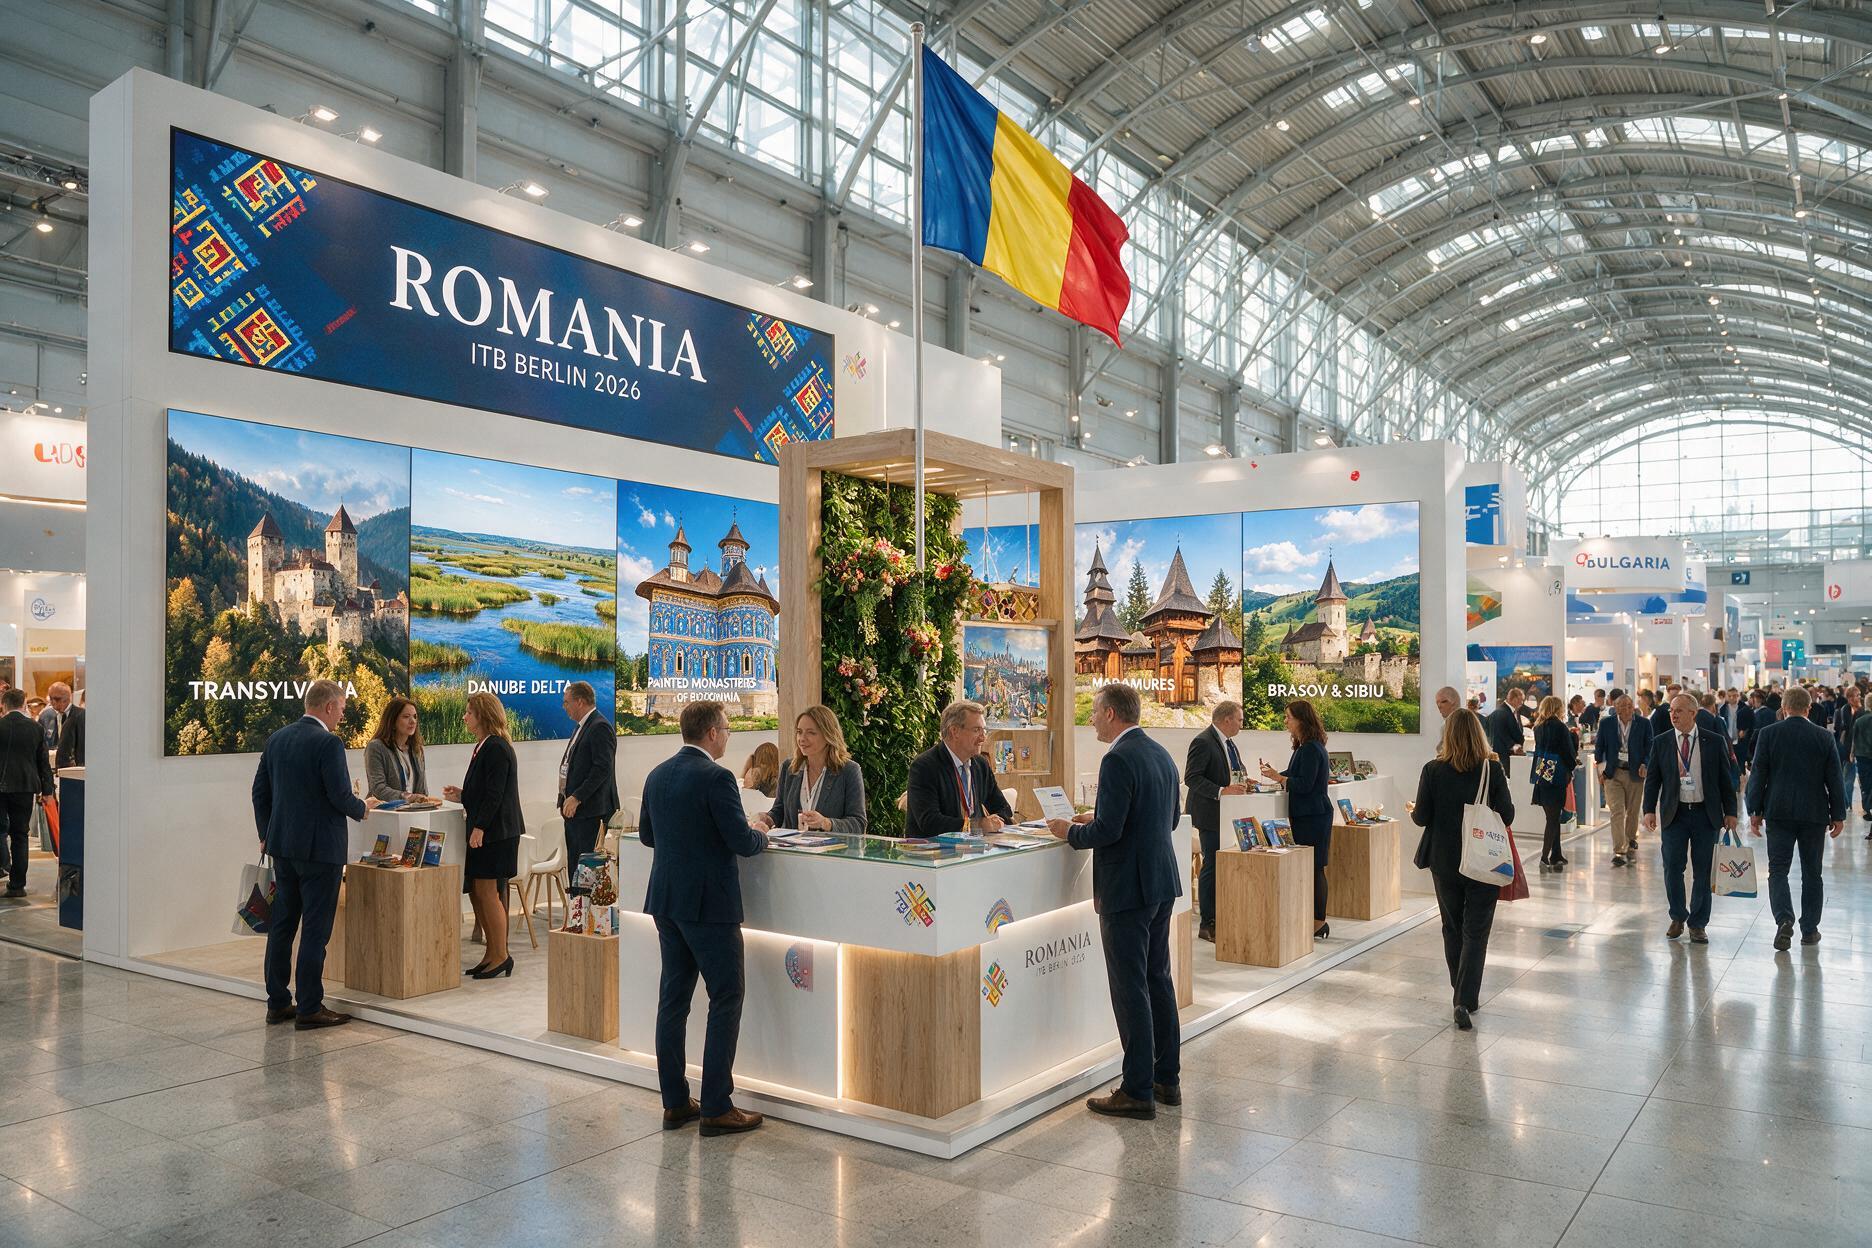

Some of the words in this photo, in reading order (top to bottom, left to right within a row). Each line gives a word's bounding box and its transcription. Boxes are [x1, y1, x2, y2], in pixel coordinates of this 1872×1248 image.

[389, 245, 707, 383] ROMANIA
[471, 342, 507, 370] ITB
[515, 352, 587, 388] BERLIN
[594, 371, 641, 400] 2026
[1587, 556, 1670, 570] BULGARIA
[188, 680, 358, 700] TRANSYLVA
[467, 680, 526, 695] DANUBE
[647, 677, 689, 689] PAINTED
[1267, 683, 1328, 697] BRASOV
[1331, 684, 1342, 697] &
[1344, 684, 1384, 698] SIBIU
[676, 692, 688, 702] OF
[1025, 931, 1091, 968] ROMANIA
